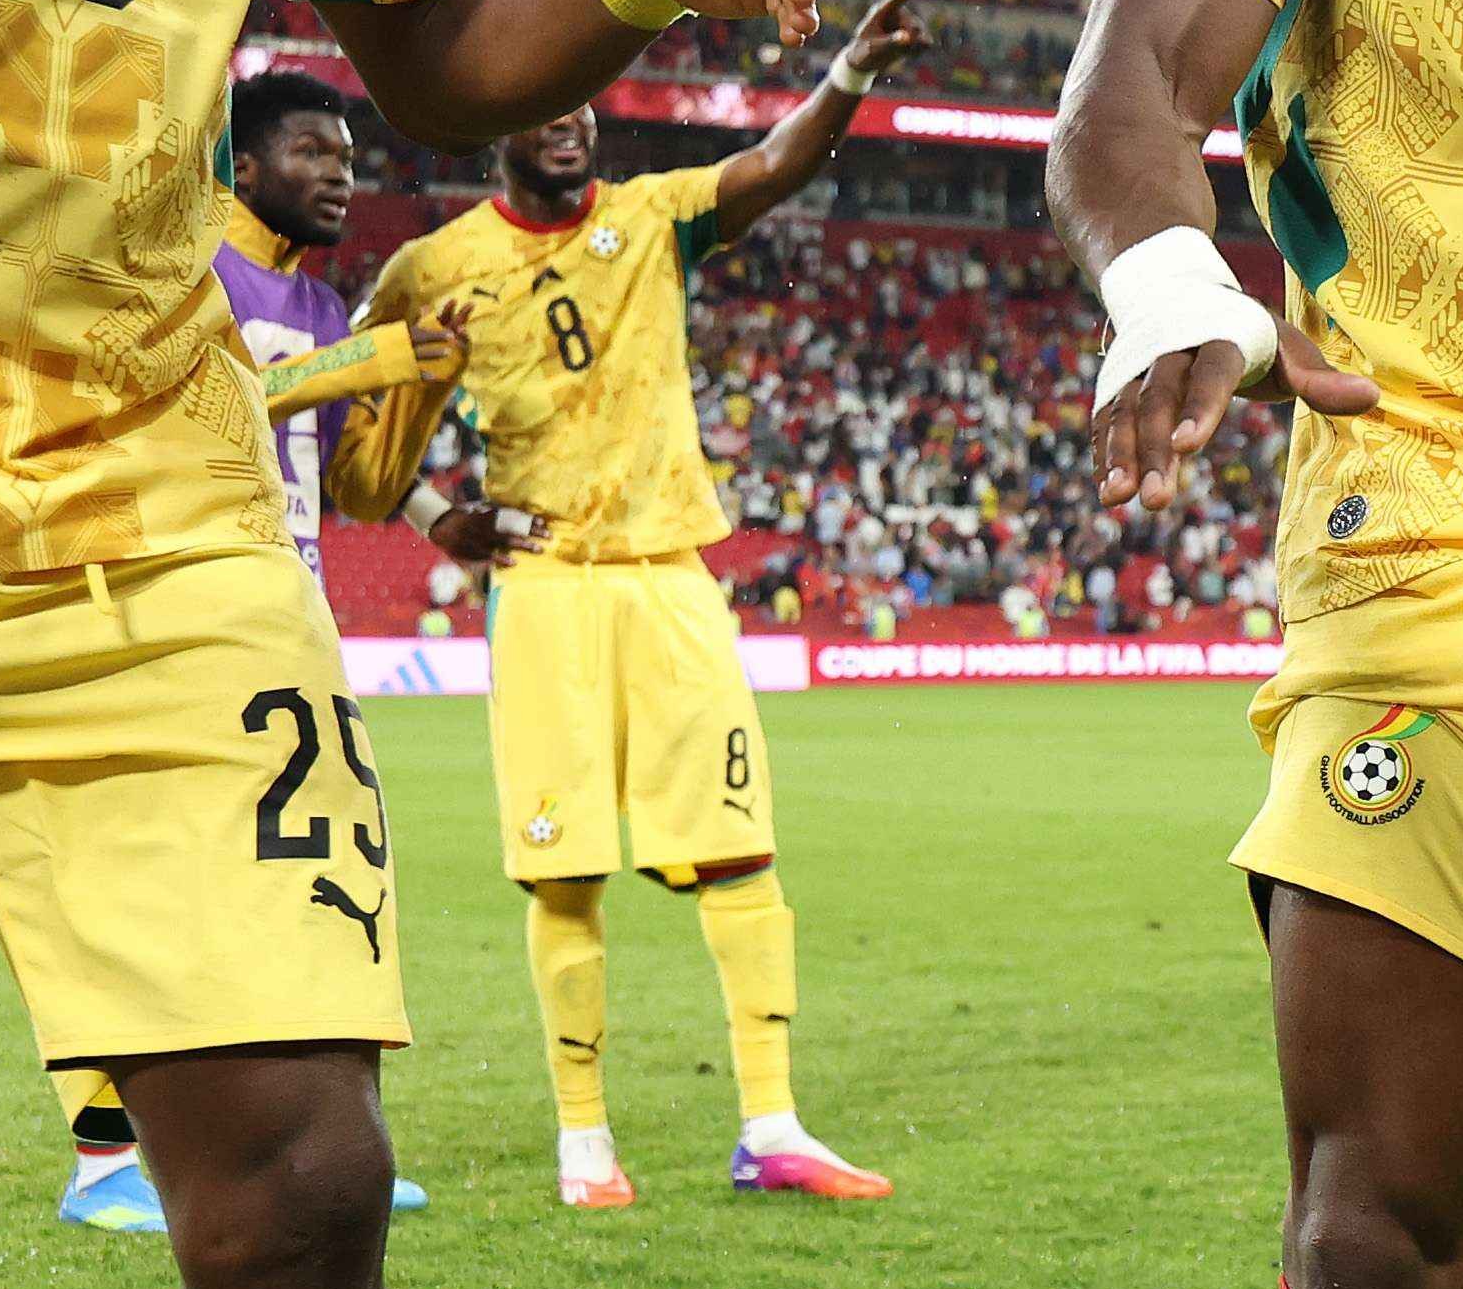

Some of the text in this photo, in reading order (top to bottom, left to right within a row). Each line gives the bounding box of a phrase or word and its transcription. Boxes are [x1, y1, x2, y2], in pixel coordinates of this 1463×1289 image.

[547, 296, 593, 372] 8
[820, 644, 918, 677] COUPE
[920, 644, 964, 676] DU
[966, 644, 1066, 675] MONDE
[1068, 644, 1106, 675] DE
[1107, 643, 1146, 675] LA
[1146, 643, 1207, 675] FIFA
[242, 686, 388, 871] 25
[725, 727, 750, 790] 8
[1320, 755, 1426, 825] GHANA FOOTBALL ASSOCIATION
